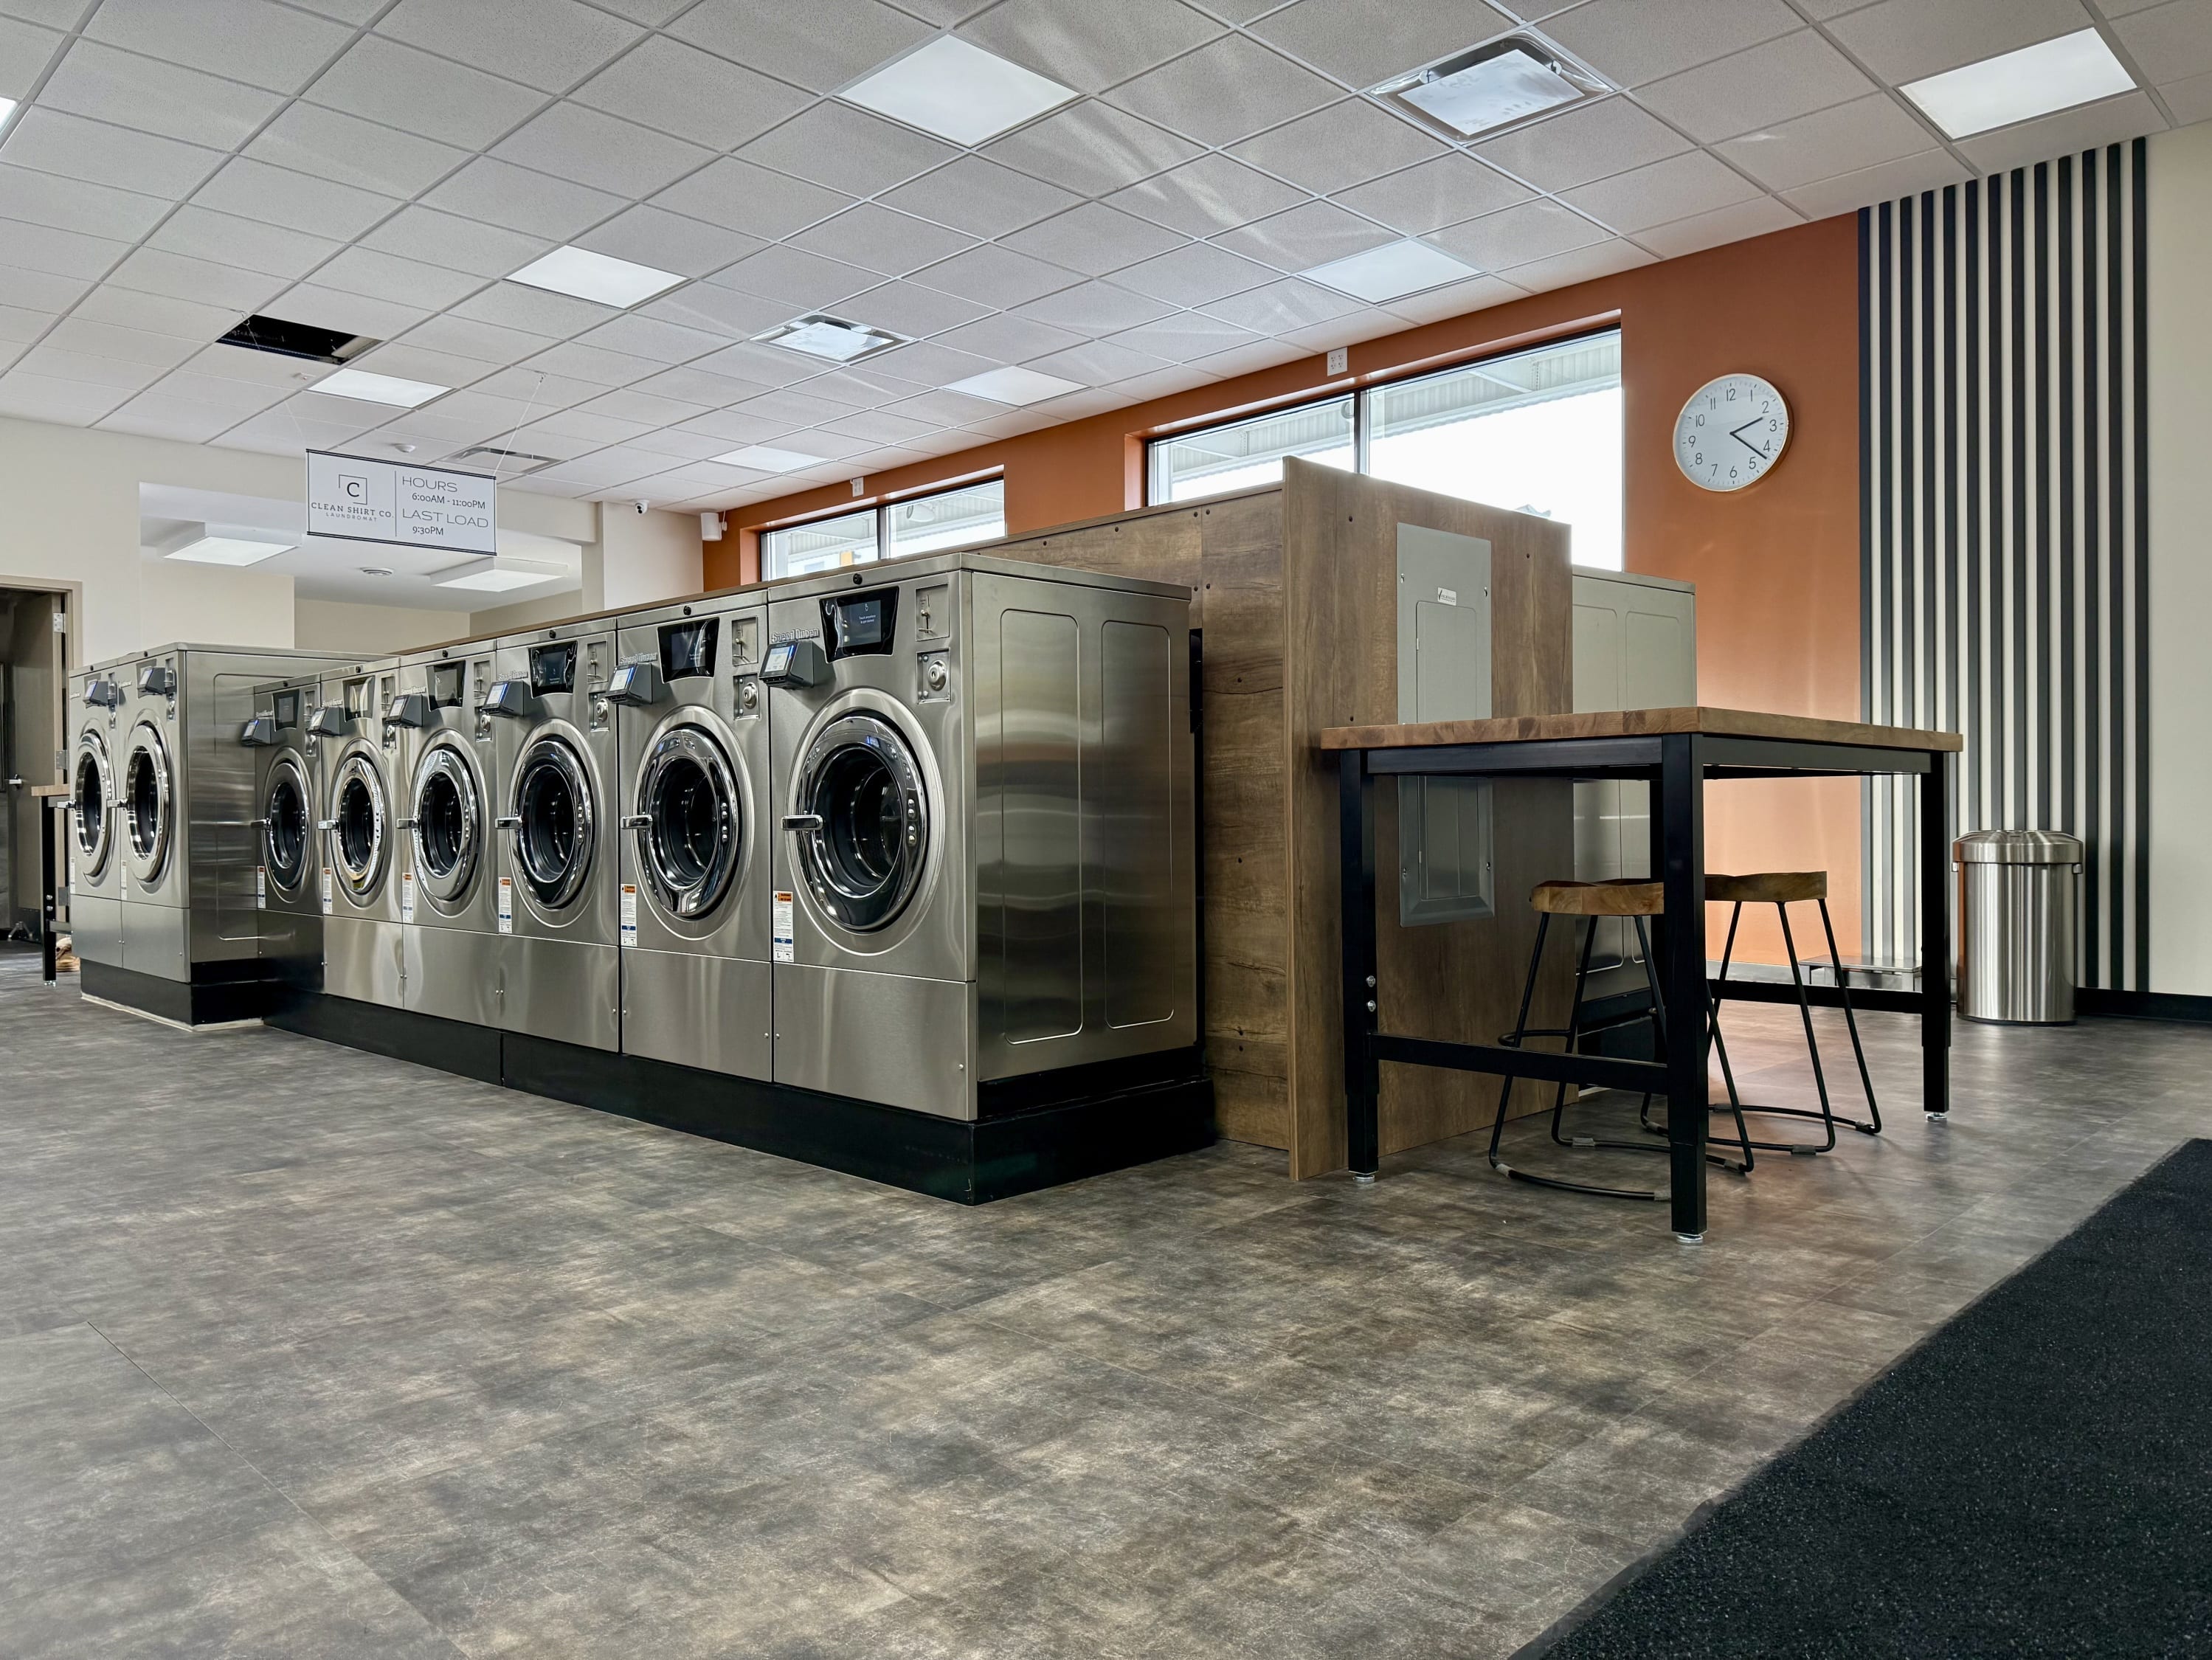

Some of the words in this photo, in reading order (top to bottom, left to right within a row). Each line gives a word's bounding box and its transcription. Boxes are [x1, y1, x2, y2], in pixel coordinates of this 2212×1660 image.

[1726, 388, 1736, 401] 12
[1710, 398, 1716, 410] 11
[1762, 401, 1769, 414] 2
[1696, 414, 1705, 427] 10
[1769, 419, 1777, 432] 3
[1688, 435, 1696, 448] 9
[1763, 439, 1771, 452] 4
[1695, 452, 1703, 465] 8
[1749, 456, 1757, 470] 5
[1711, 464, 1718, 477] 7
[1729, 466, 1738, 478] 6
[347, 482, 359, 497] C
[402, 476, 457, 492] HOURS
[412, 492, 445, 504] 6:00AM
[452, 499, 485, 509] 11:00PM
[311, 502, 343, 512] CLEAN
[348, 506, 376, 516] SHIRT
[379, 510, 394, 518] CO.
[325, 512, 377, 522] LAUNDROMAT
[402, 508, 443, 522] LAST
[446, 513, 488, 528] LOAD
[412, 526, 443, 536] 9:30PM
[771, 629, 795, 643] Speed
[795, 628, 820, 640] Queen
